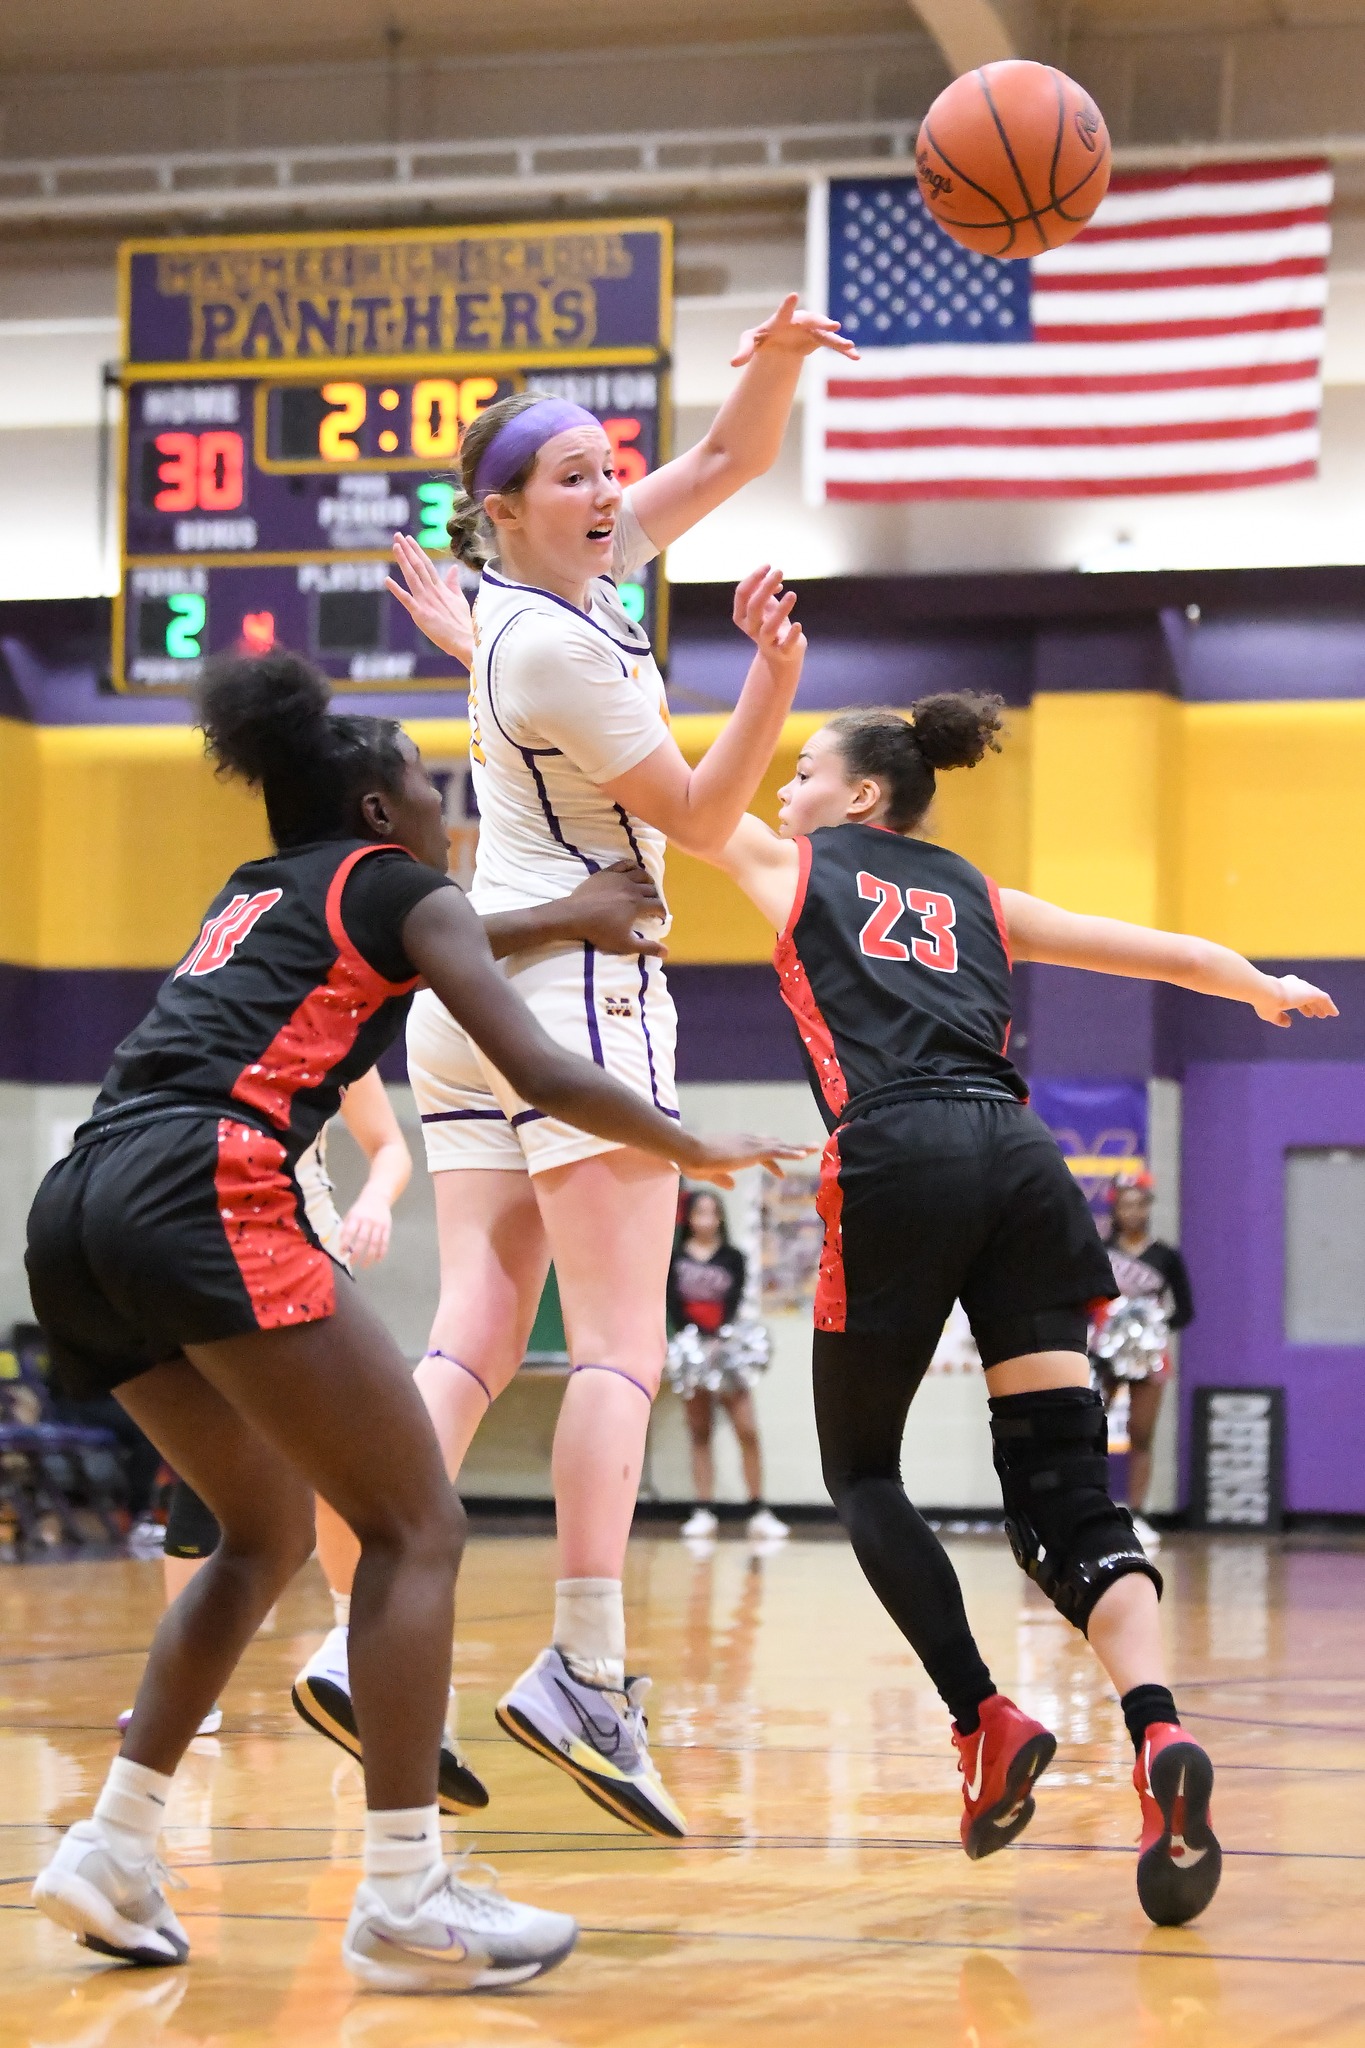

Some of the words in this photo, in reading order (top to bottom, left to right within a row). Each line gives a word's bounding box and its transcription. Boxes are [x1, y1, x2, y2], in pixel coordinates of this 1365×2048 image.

[196, 284, 592, 360] PANTHERS
[154, 431, 244, 513] 30
[417, 482, 454, 548] 3
[166, 593, 206, 659] 2
[856, 870, 959, 973] 23
